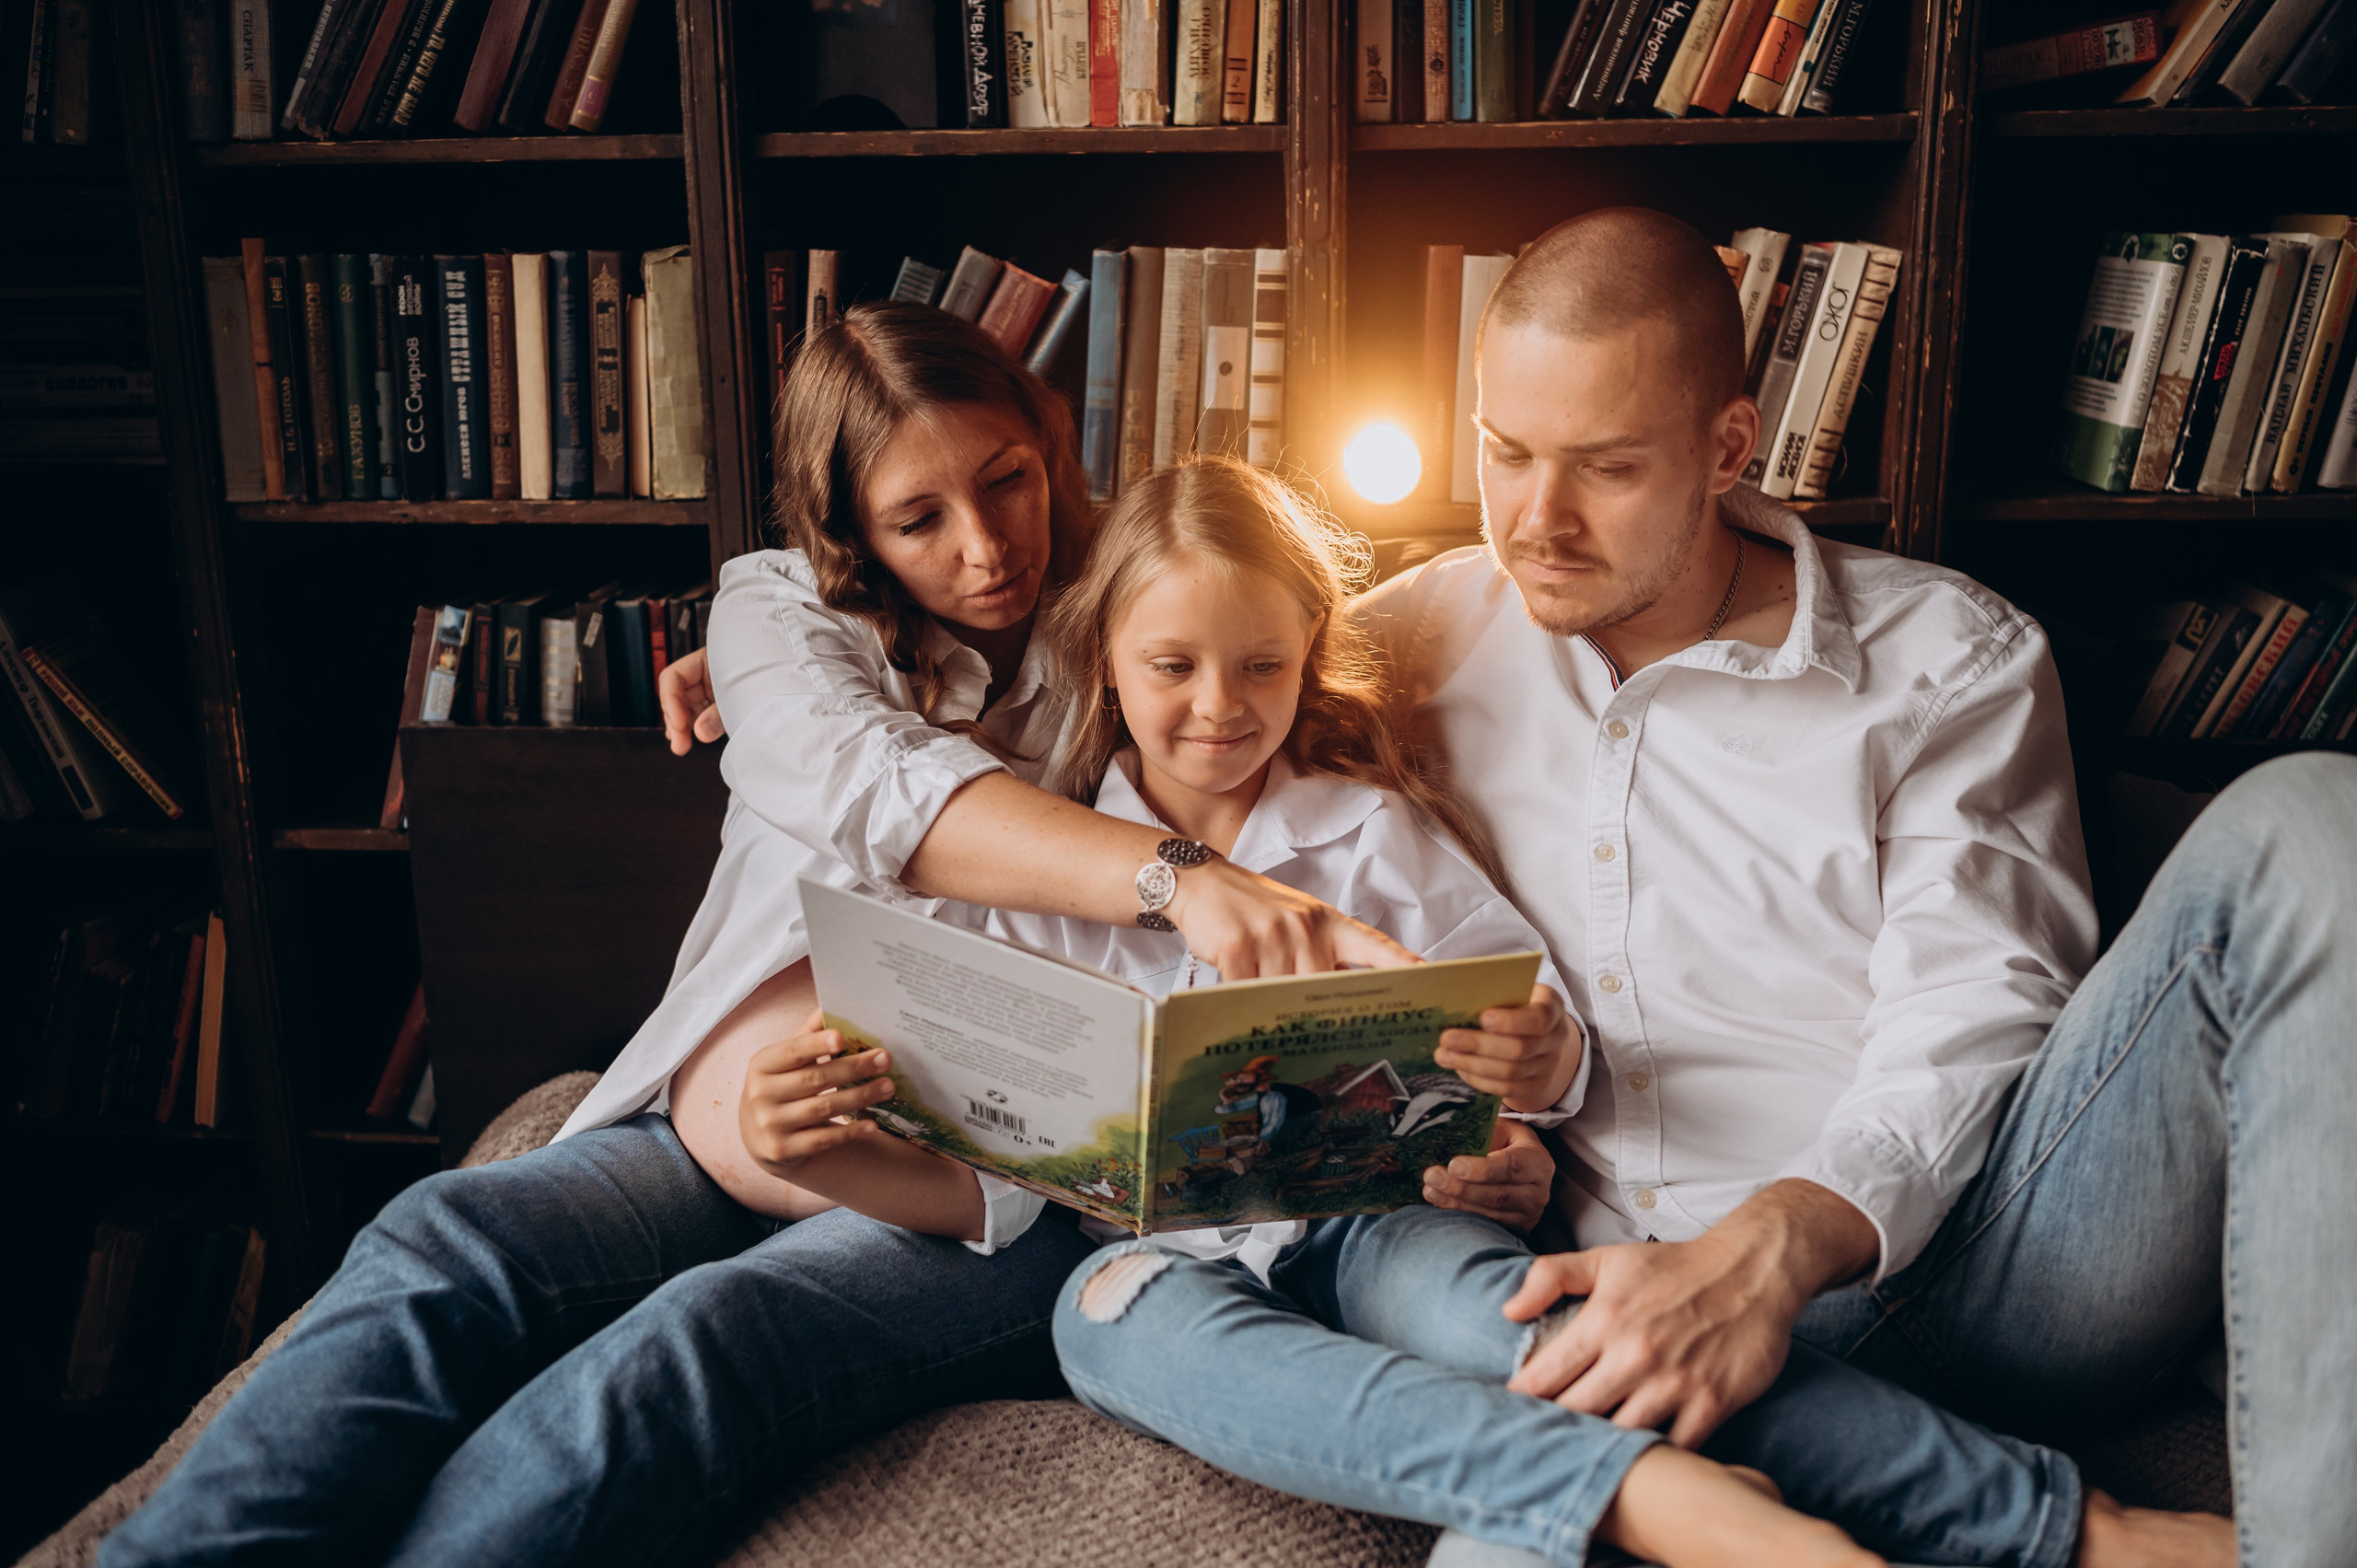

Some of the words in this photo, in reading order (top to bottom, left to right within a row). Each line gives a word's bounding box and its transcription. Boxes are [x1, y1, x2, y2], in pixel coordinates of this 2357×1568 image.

[243, 10, 253, 72] СПАРТАК
[414, 48, 439, 78] ЧЕГО
[1231, 75, 1240, 87] 2
[1591, 36, 1624, 101] Американская
[407, 75, 427, 95] НЕ
[393, 91, 419, 127] БЫЛО
[445, 271, 468, 298] СУД
[1817, 280, 1852, 344] ОЖОГ
[445, 303, 471, 382] СТРАШНЫЙ
[2138, 333, 2165, 391] ЗОЛОТОМ
[2154, 309, 2170, 333] УСЕ
[2266, 382, 2294, 446] ВАЦЛАВ
[2282, 261, 2327, 375] МИХАЛЬСКИЙ
[404, 336, 426, 412] Смирнов
[282, 376, 294, 424] ГОГОЛЬ
[84, 716, 123, 758] ПОЛНЫЙ
[1250, 1020, 1307, 1037] КАК
[1315, 1007, 1435, 1030] ФИНДУС
[1377, 999, 1412, 1011] ТОМ
[1014, 1134, 1033, 1146] 0+
